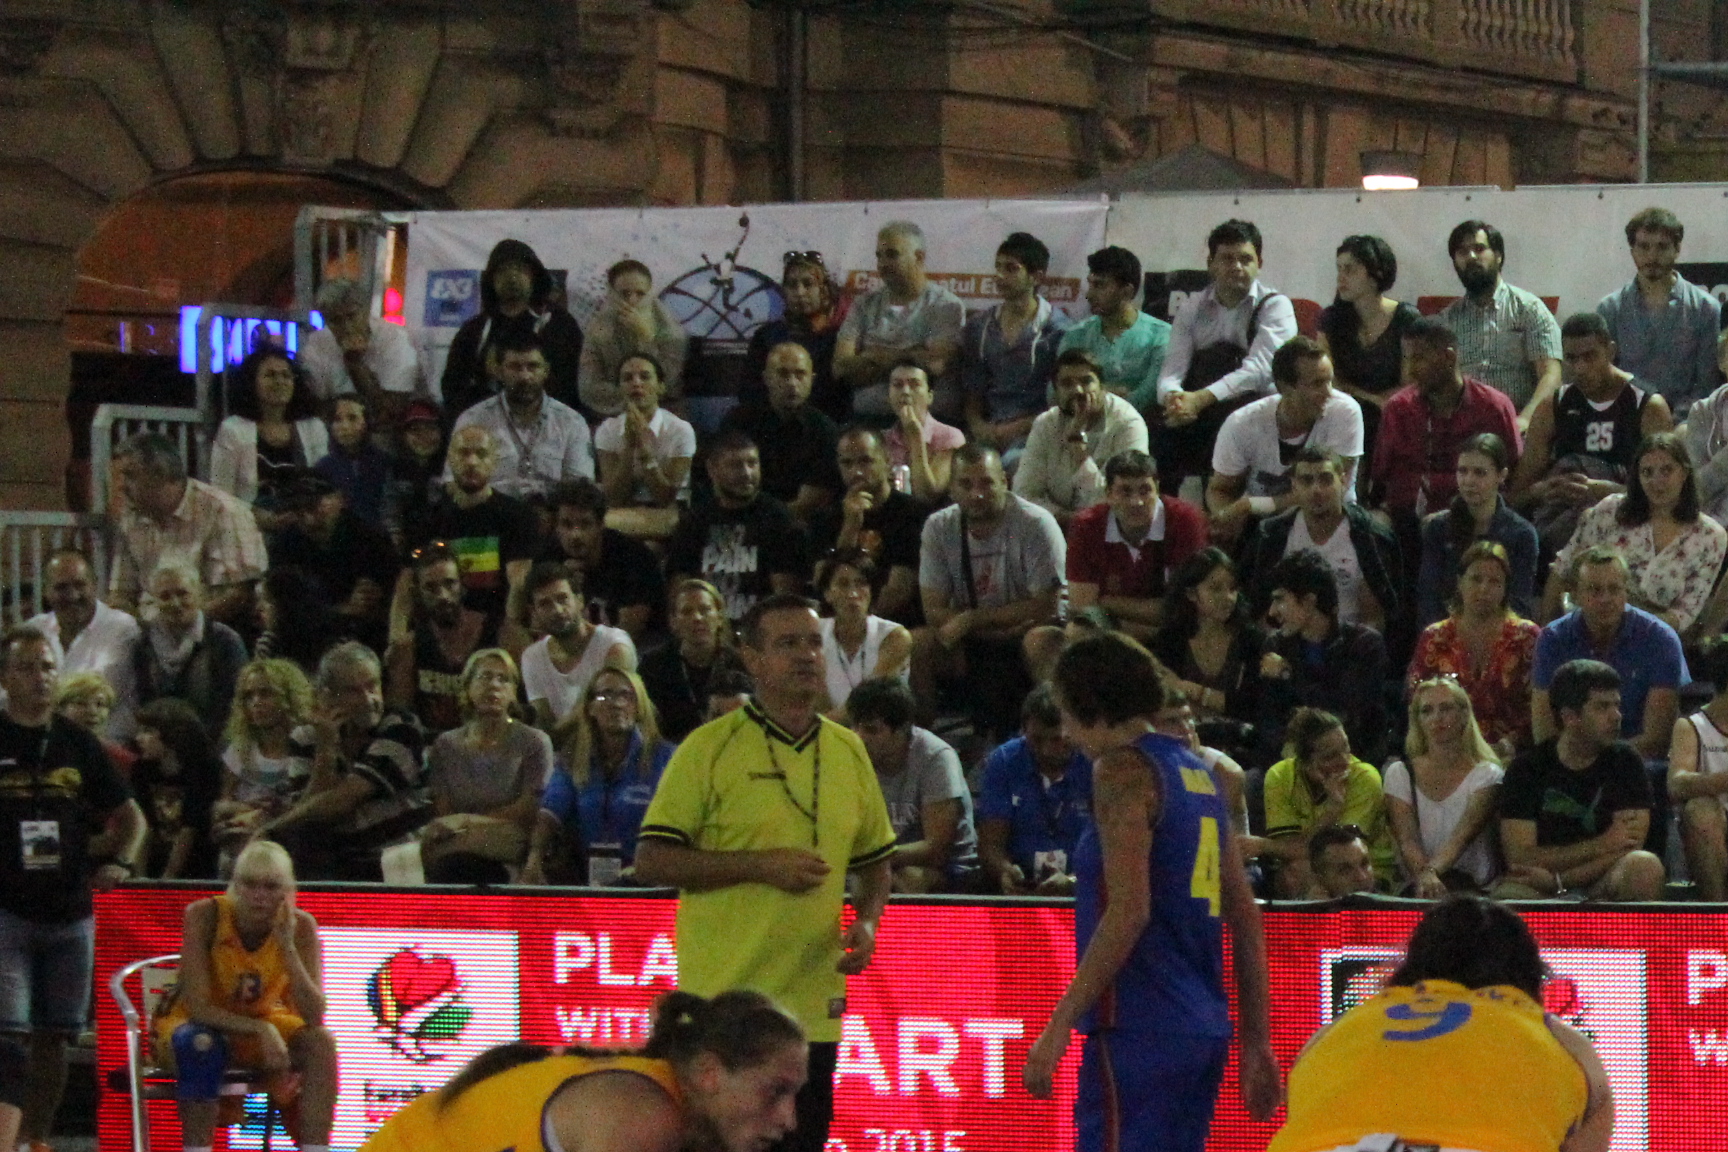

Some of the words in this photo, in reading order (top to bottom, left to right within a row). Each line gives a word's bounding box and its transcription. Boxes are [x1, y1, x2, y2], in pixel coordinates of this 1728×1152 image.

[1585, 421, 1615, 451] 25
[702, 544, 758, 573] PAIN
[1190, 816, 1221, 917] 4
[553, 930, 679, 986] PLA
[831, 1014, 1025, 1098] ART
